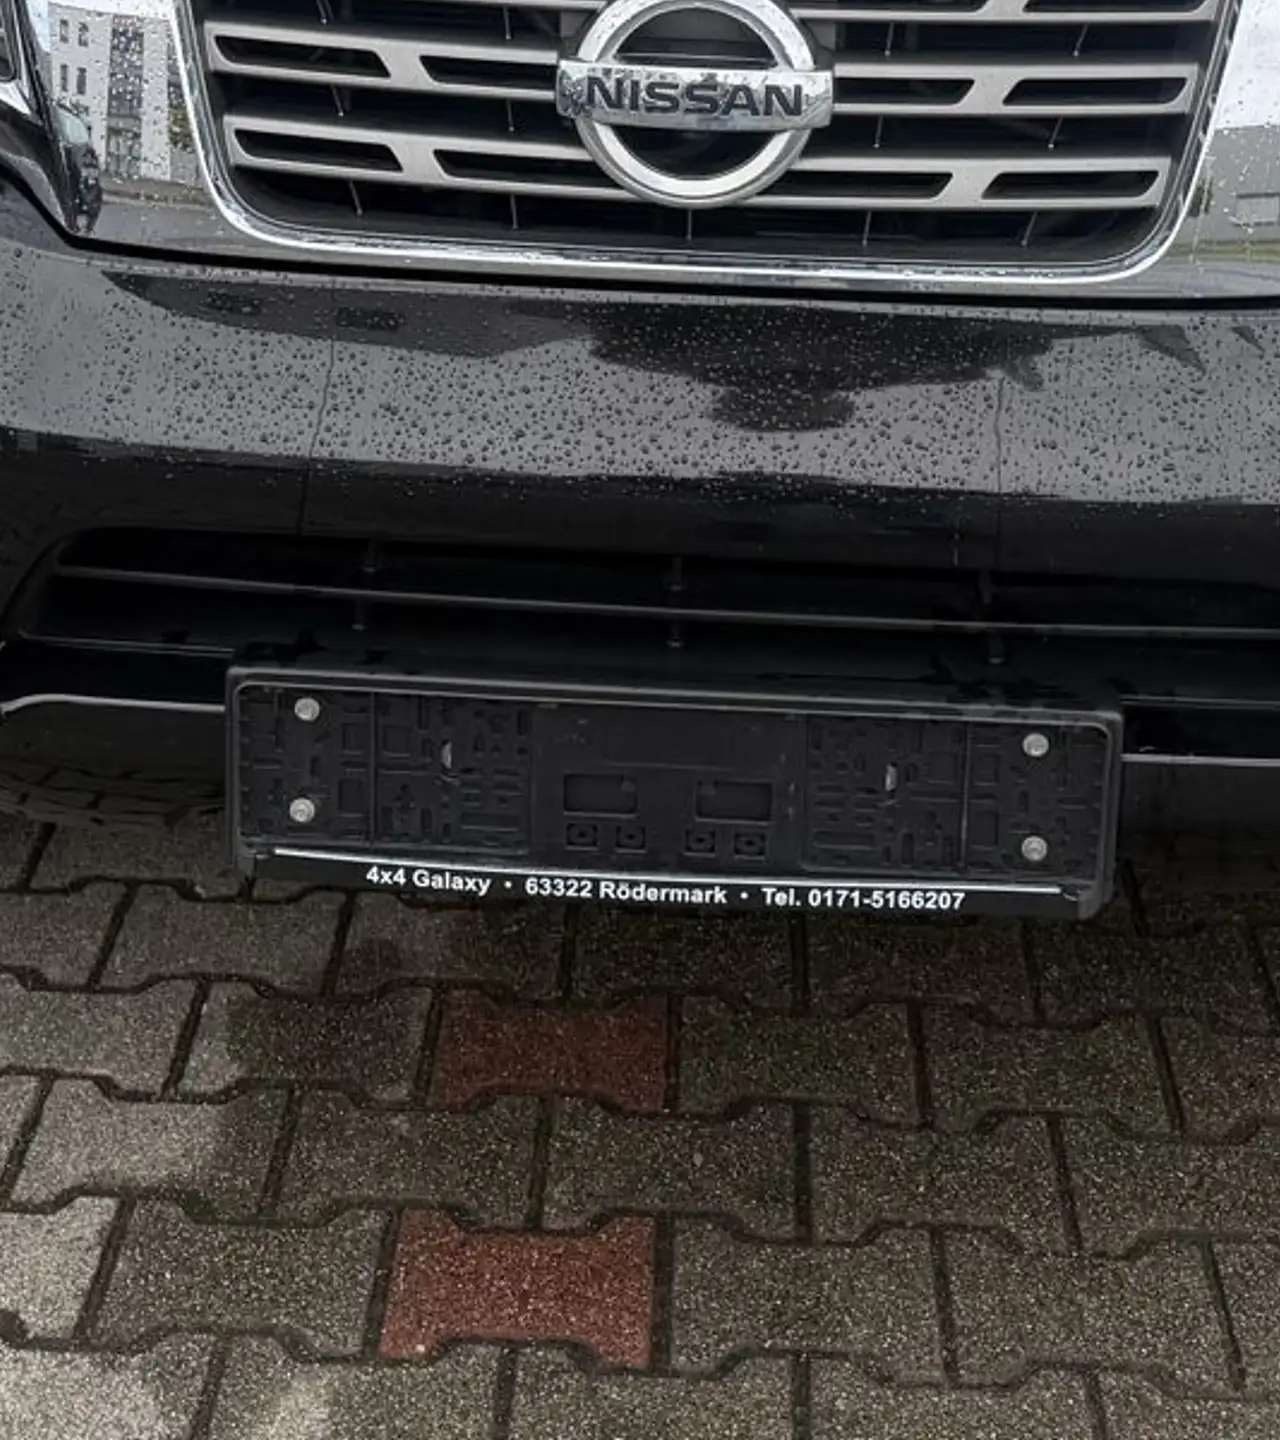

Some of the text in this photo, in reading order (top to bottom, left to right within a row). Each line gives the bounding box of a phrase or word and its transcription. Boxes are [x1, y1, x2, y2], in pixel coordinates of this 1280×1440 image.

[586, 75, 802, 117] NISSAN
[366, 865, 966, 910] 4x4 Galaxy 63322 Rödermark Tel. 0171-5166207
